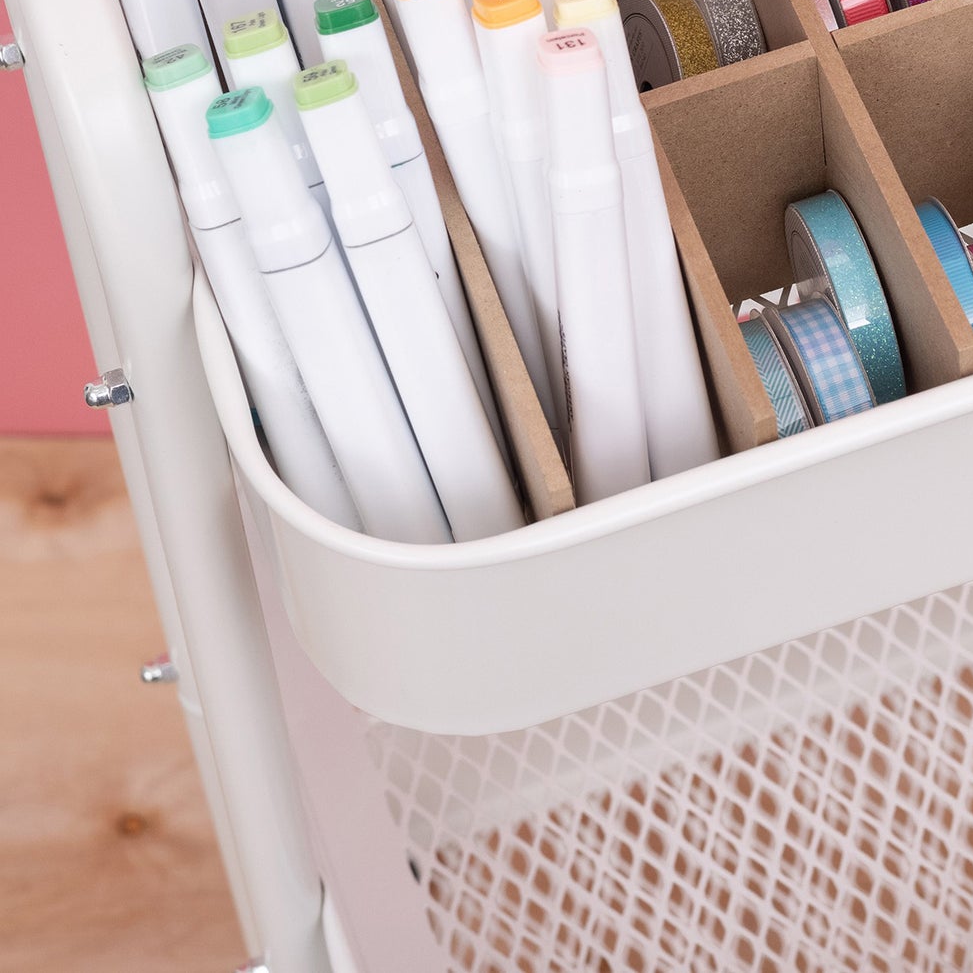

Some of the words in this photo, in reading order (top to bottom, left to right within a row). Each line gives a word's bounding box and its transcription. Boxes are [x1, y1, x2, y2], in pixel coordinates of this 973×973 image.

[546, 32, 585, 43] Porcelain
[556, 39, 587, 51] 131
[213, 96, 231, 109] 58
